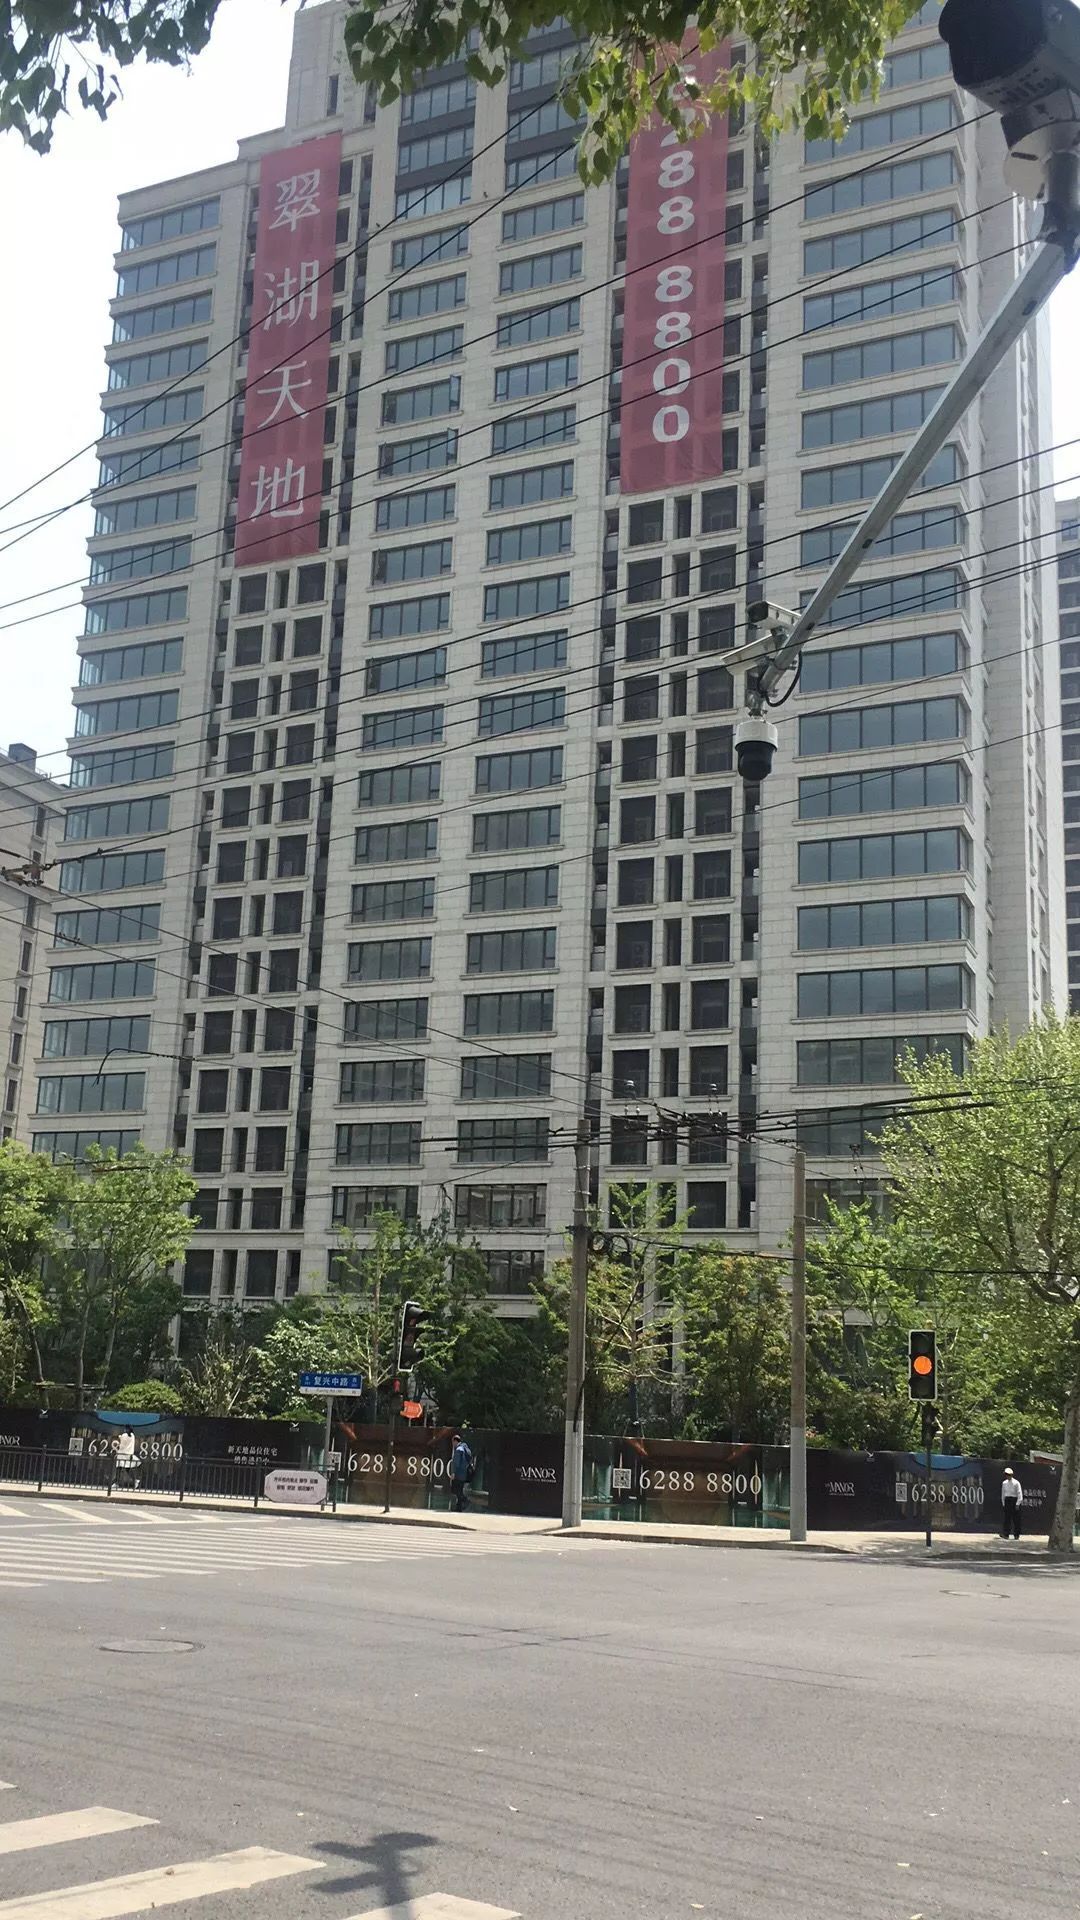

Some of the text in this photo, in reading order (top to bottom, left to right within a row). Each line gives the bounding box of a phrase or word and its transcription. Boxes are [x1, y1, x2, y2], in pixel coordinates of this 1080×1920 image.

[249, 167, 322, 524] 翠湖天地
[314, 1375, 349, 1387] 复兴中路
[139, 1441, 184, 1462] 8800
[639, 1469, 762, 1495] 6288 8800
[951, 1484, 984, 1505] 8800
